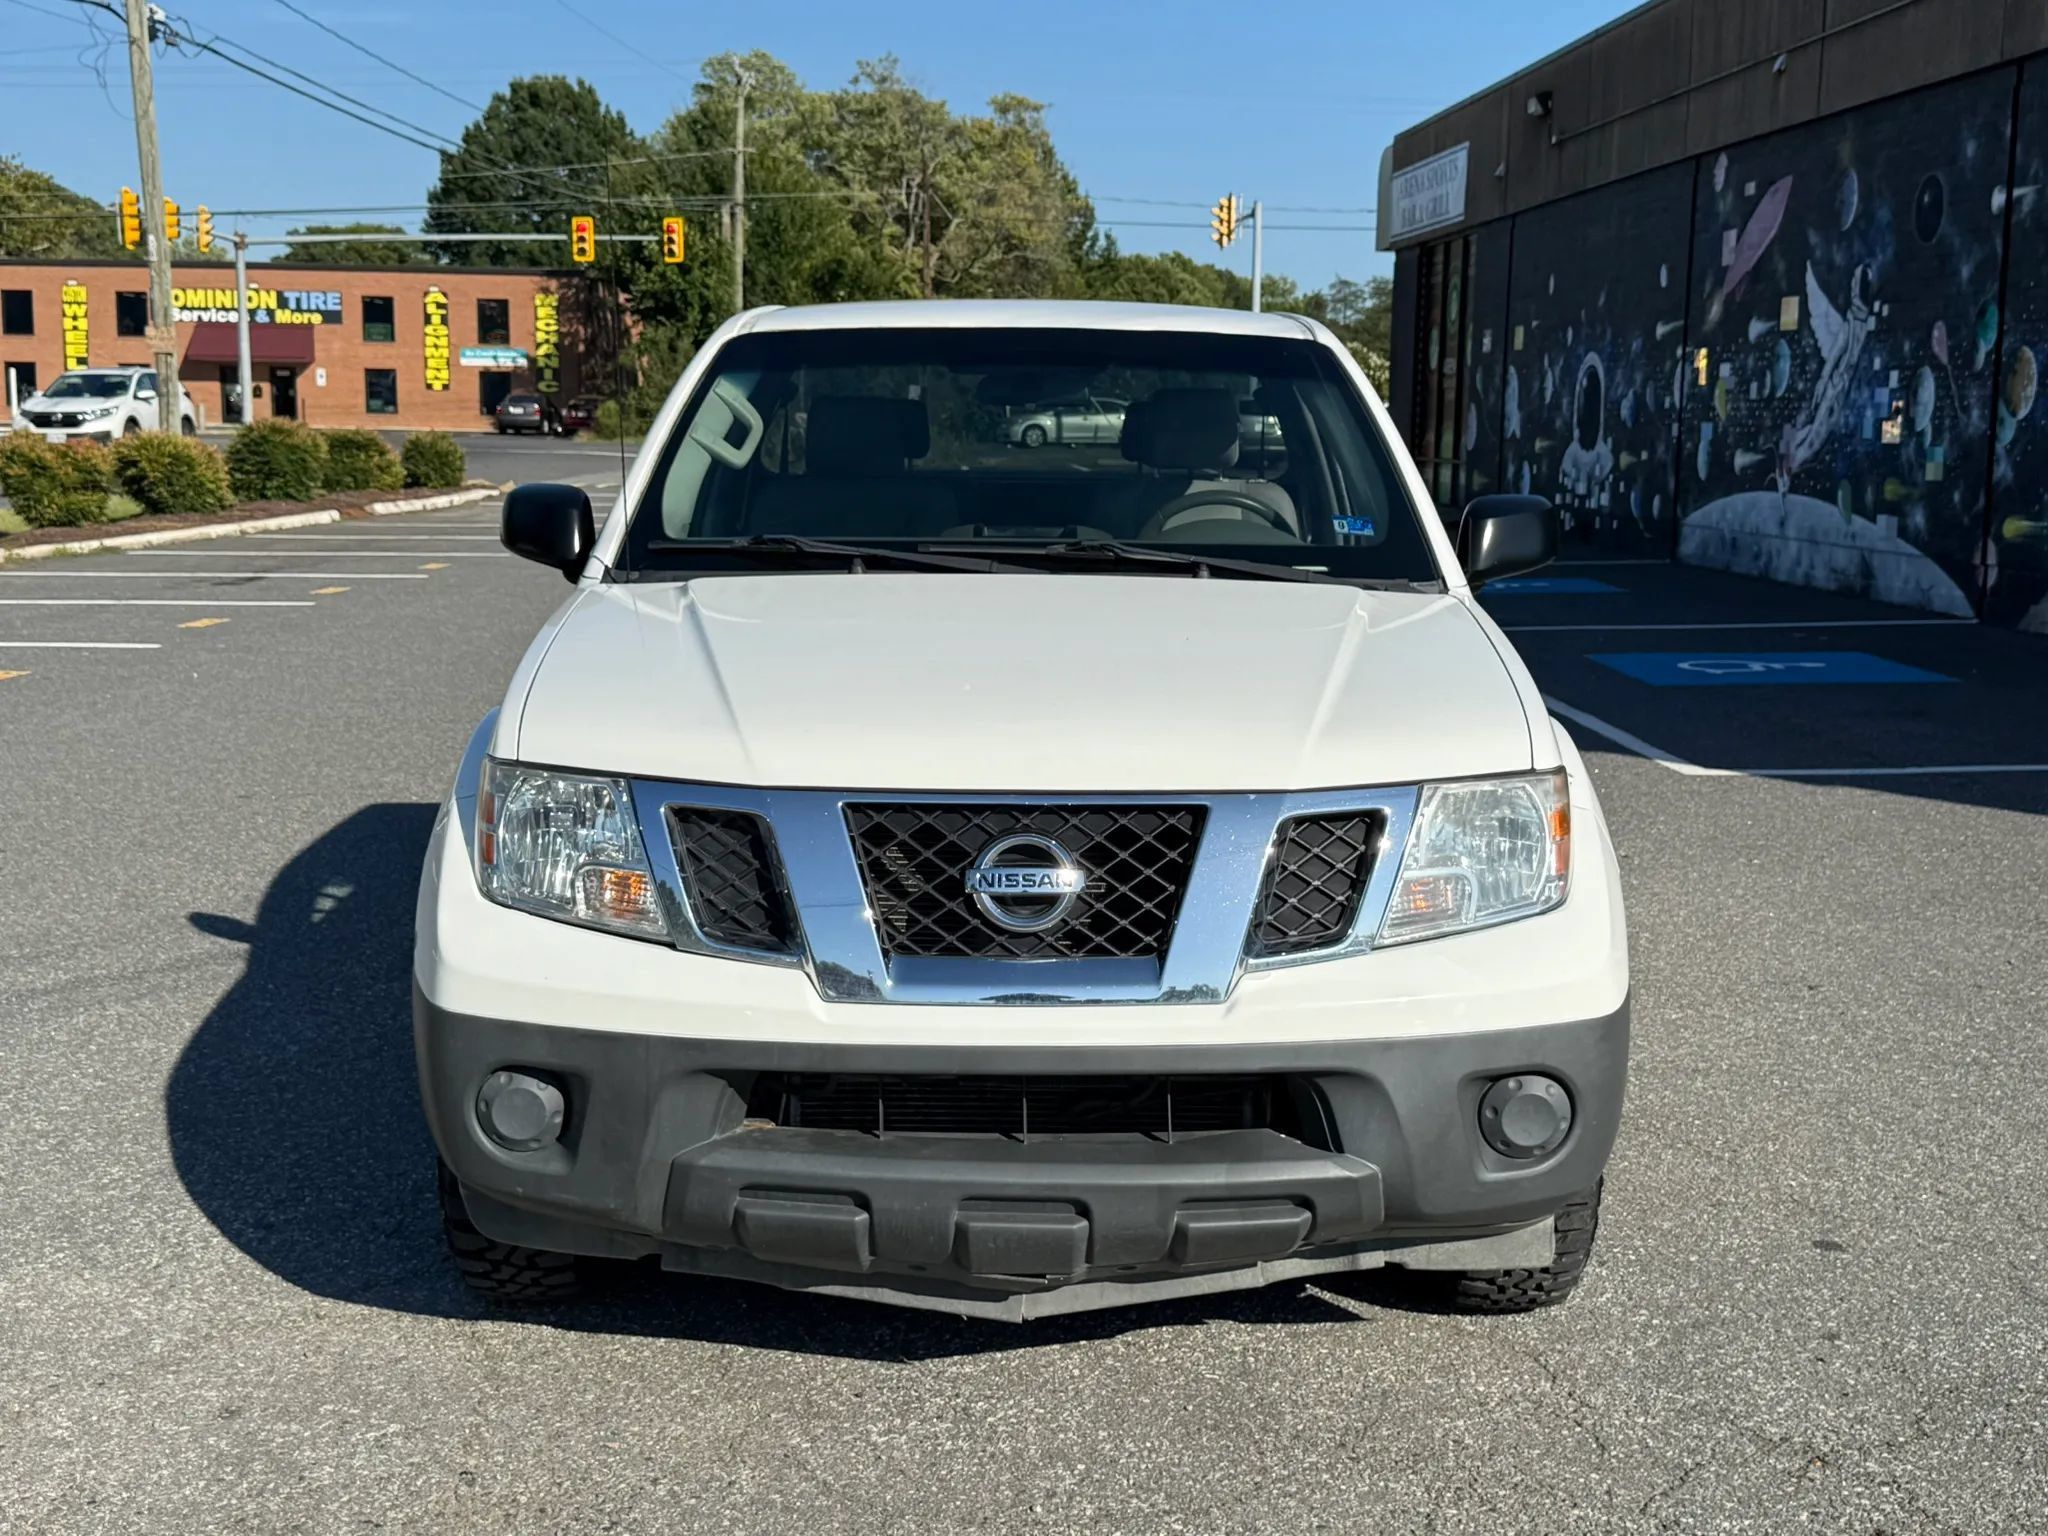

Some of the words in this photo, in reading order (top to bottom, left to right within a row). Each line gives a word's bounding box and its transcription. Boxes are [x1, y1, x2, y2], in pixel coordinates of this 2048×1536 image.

[171, 288, 278, 310] OMINION
[283, 291, 342, 310] TIRE
[171, 308, 250, 323] Service
[255, 309, 270, 324] &
[275, 309, 323, 325] More
[424, 292, 449, 391] ALIGNMENT
[534, 293, 560, 393] MECHANIC
[978, 873, 1073, 889] NISSAN
